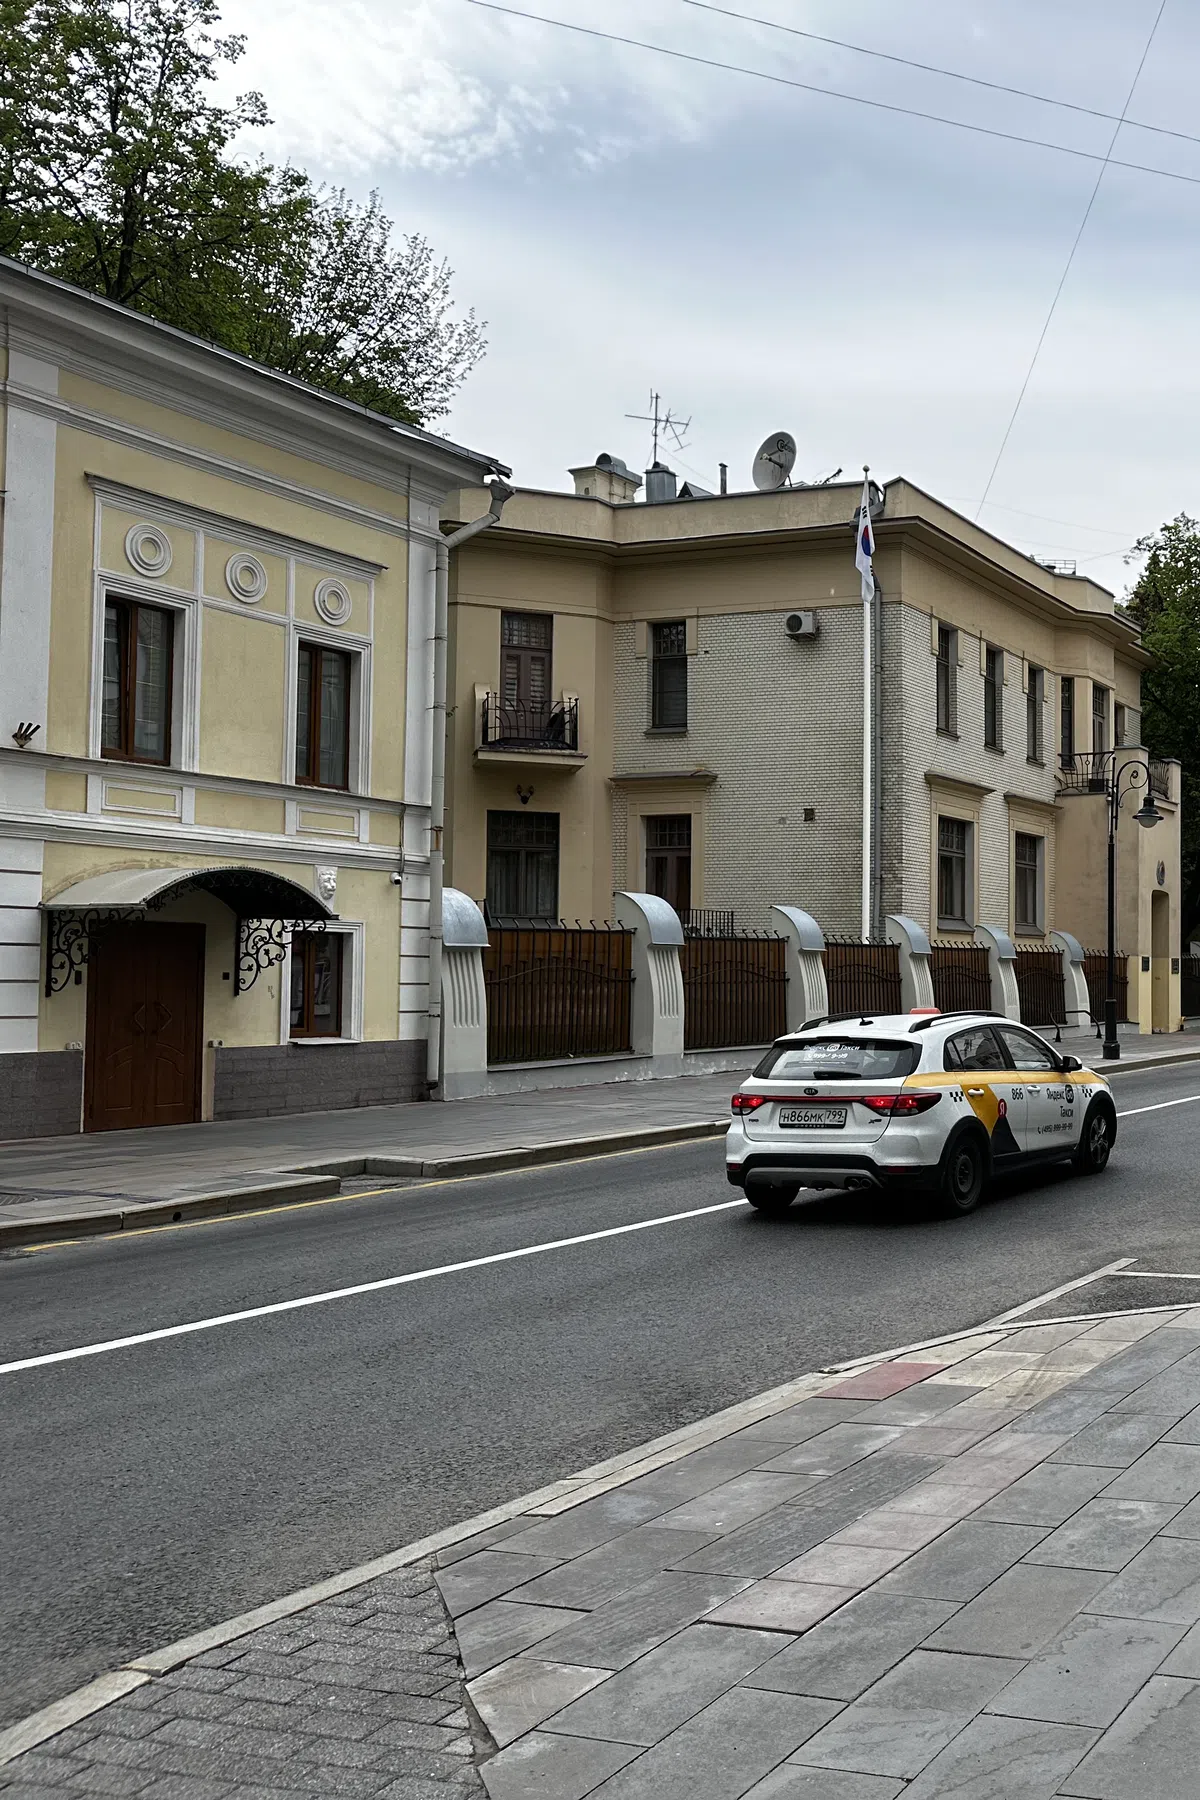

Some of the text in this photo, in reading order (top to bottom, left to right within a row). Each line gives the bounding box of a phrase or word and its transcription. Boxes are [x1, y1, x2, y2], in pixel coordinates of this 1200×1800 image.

[1012, 1088, 1023, 1100] 866
[783, 1110, 843, 1123] Н866МК 799
